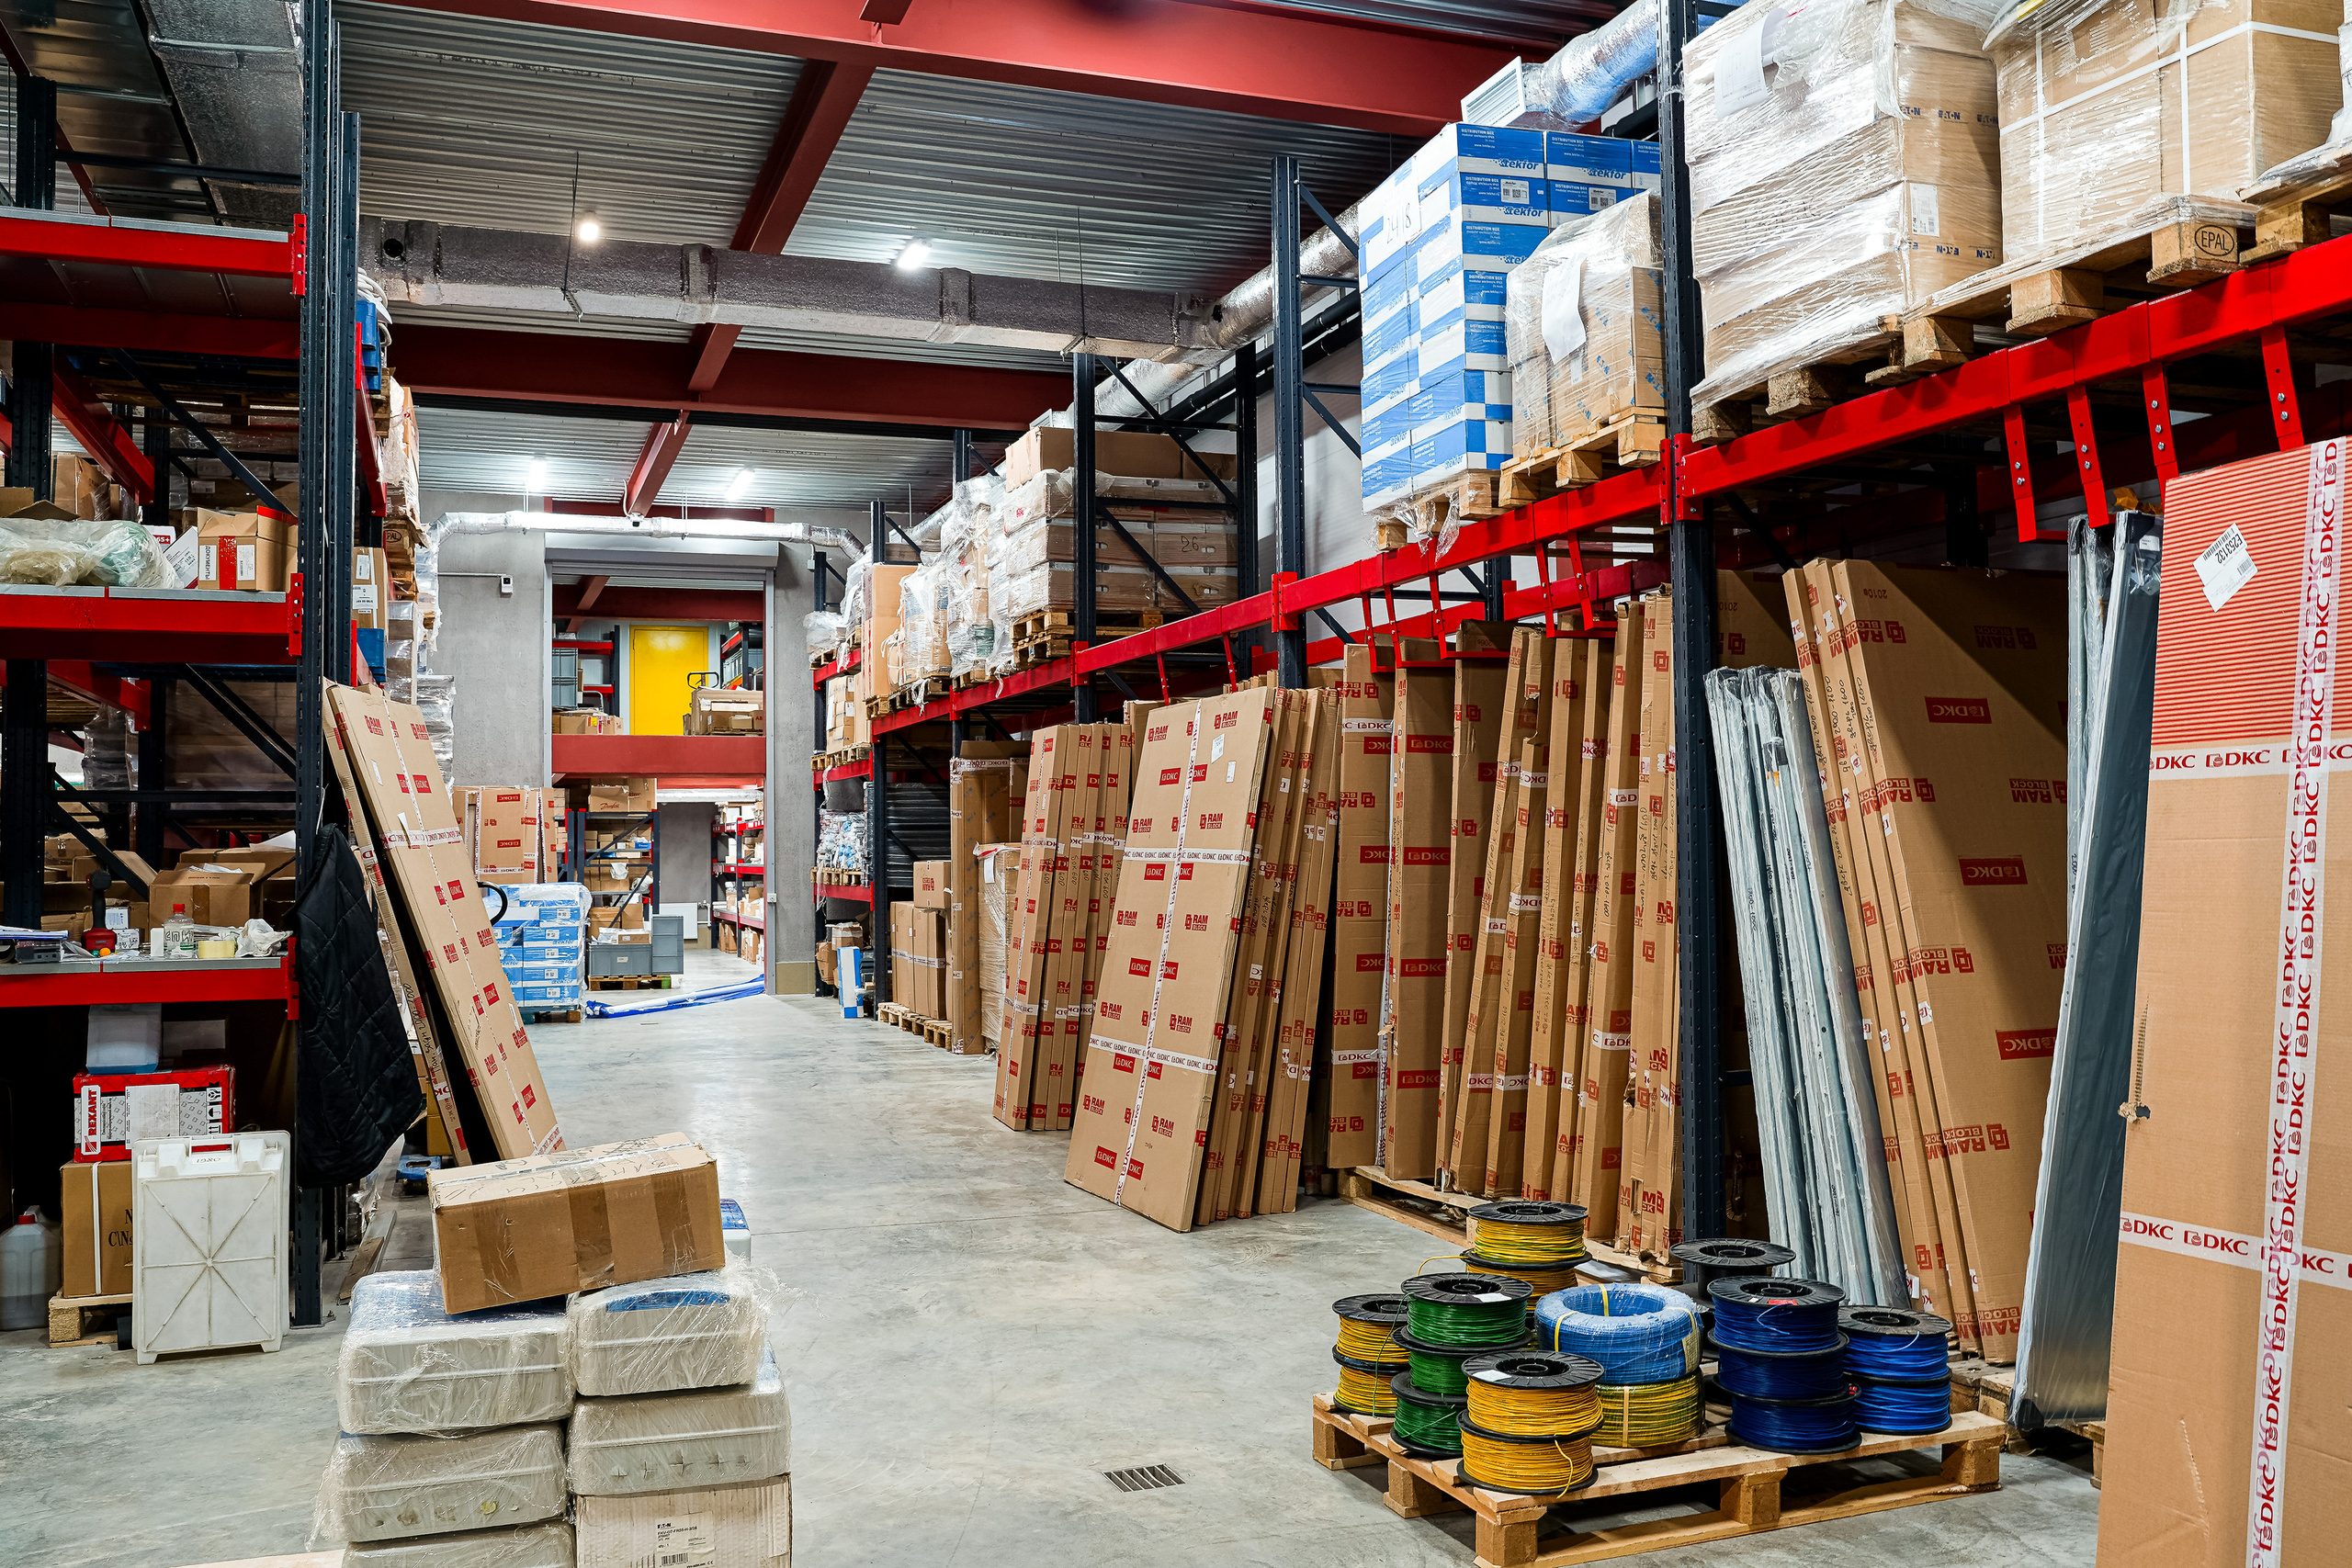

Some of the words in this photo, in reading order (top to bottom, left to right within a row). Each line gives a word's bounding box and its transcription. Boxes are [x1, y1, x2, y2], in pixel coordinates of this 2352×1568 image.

[1499, 159, 1539, 170] tekfor
[1588, 168, 1626, 180] tekfor
[1503, 206, 1543, 217] tekfor
[2200, 230, 2230, 253] EPAL
[2320, 499, 2335, 553] DKC
[1181, 536, 1199, 553] 26
[2314, 592, 2330, 648] DKC
[1845, 620, 1879, 634] BLOCK
[1845, 630, 1884, 648] RAM
[1222, 711, 1238, 721] RAM
[1932, 705, 1966, 717] DKC
[2310, 688, 2325, 741] DKC
[1155, 725, 1168, 734] RAM
[1430, 740, 1452, 749] DKC
[2156, 754, 2196, 771] DKC
[2225, 749, 2271, 766] DKC
[1876, 779, 1908, 792] BLOCK
[2012, 781, 2047, 789] BLOCK
[1878, 789, 1913, 809] RAM
[2012, 790, 2052, 803] RAM
[2304, 781, 2320, 838] DKC
[1208, 813, 1223, 822] RAM
[2288, 830, 2305, 886] DKC
[1180, 868, 1192, 876] DKC
[1966, 866, 2003, 878] DKC
[2300, 877, 2316, 933] DKC
[1124, 911, 1137, 920] RAM
[1193, 915, 1208, 924] RAM
[1911, 950, 1945, 962] BLOCK
[2282, 926, 2299, 982] DKC
[1136, 964, 1148, 972] DKC
[1165, 966, 1176, 975] DKC
[1911, 960, 1951, 978] RAM
[1109, 1003, 1122, 1013] RAM
[2296, 974, 2312, 1032] DKC
[1177, 1015, 1192, 1026] RAM
[1176, 1025, 1191, 1033] BLOCK
[2004, 1039, 2041, 1051] DKC
[2277, 1022, 2293, 1077] DKC
[1121, 1059, 1133, 1068] DKC
[1148, 1064, 1160, 1074] DKC
[1469, 1077, 1493, 1086] DKC
[1091, 1097, 1105, 1109] RAM
[2289, 1071, 2307, 1129] DKC
[88, 1090, 97, 1136] REXANT
[1090, 1106, 1104, 1115] BLOCK
[1159, 1118, 1174, 1131] RAM
[1159, 1128, 1173, 1138] BLOCK
[1945, 1127, 1980, 1139] BLOCK
[1946, 1138, 1986, 1155] RAM
[2272, 1118, 2287, 1176] DKC
[1102, 1153, 1115, 1164] DKC
[1129, 1163, 1141, 1175] DKC
[2280, 1168, 2299, 1227] DKC
[2133, 1219, 2174, 1241] DKC
[2204, 1234, 2249, 1256] DKC
[2273, 1266, 2290, 1325] DKC
[1979, 1308, 2018, 1320] BLOCK
[1980, 1318, 2021, 1336] RAM
[2266, 1365, 2282, 1425] DKC
[2260, 1463, 2276, 1523] DKC
